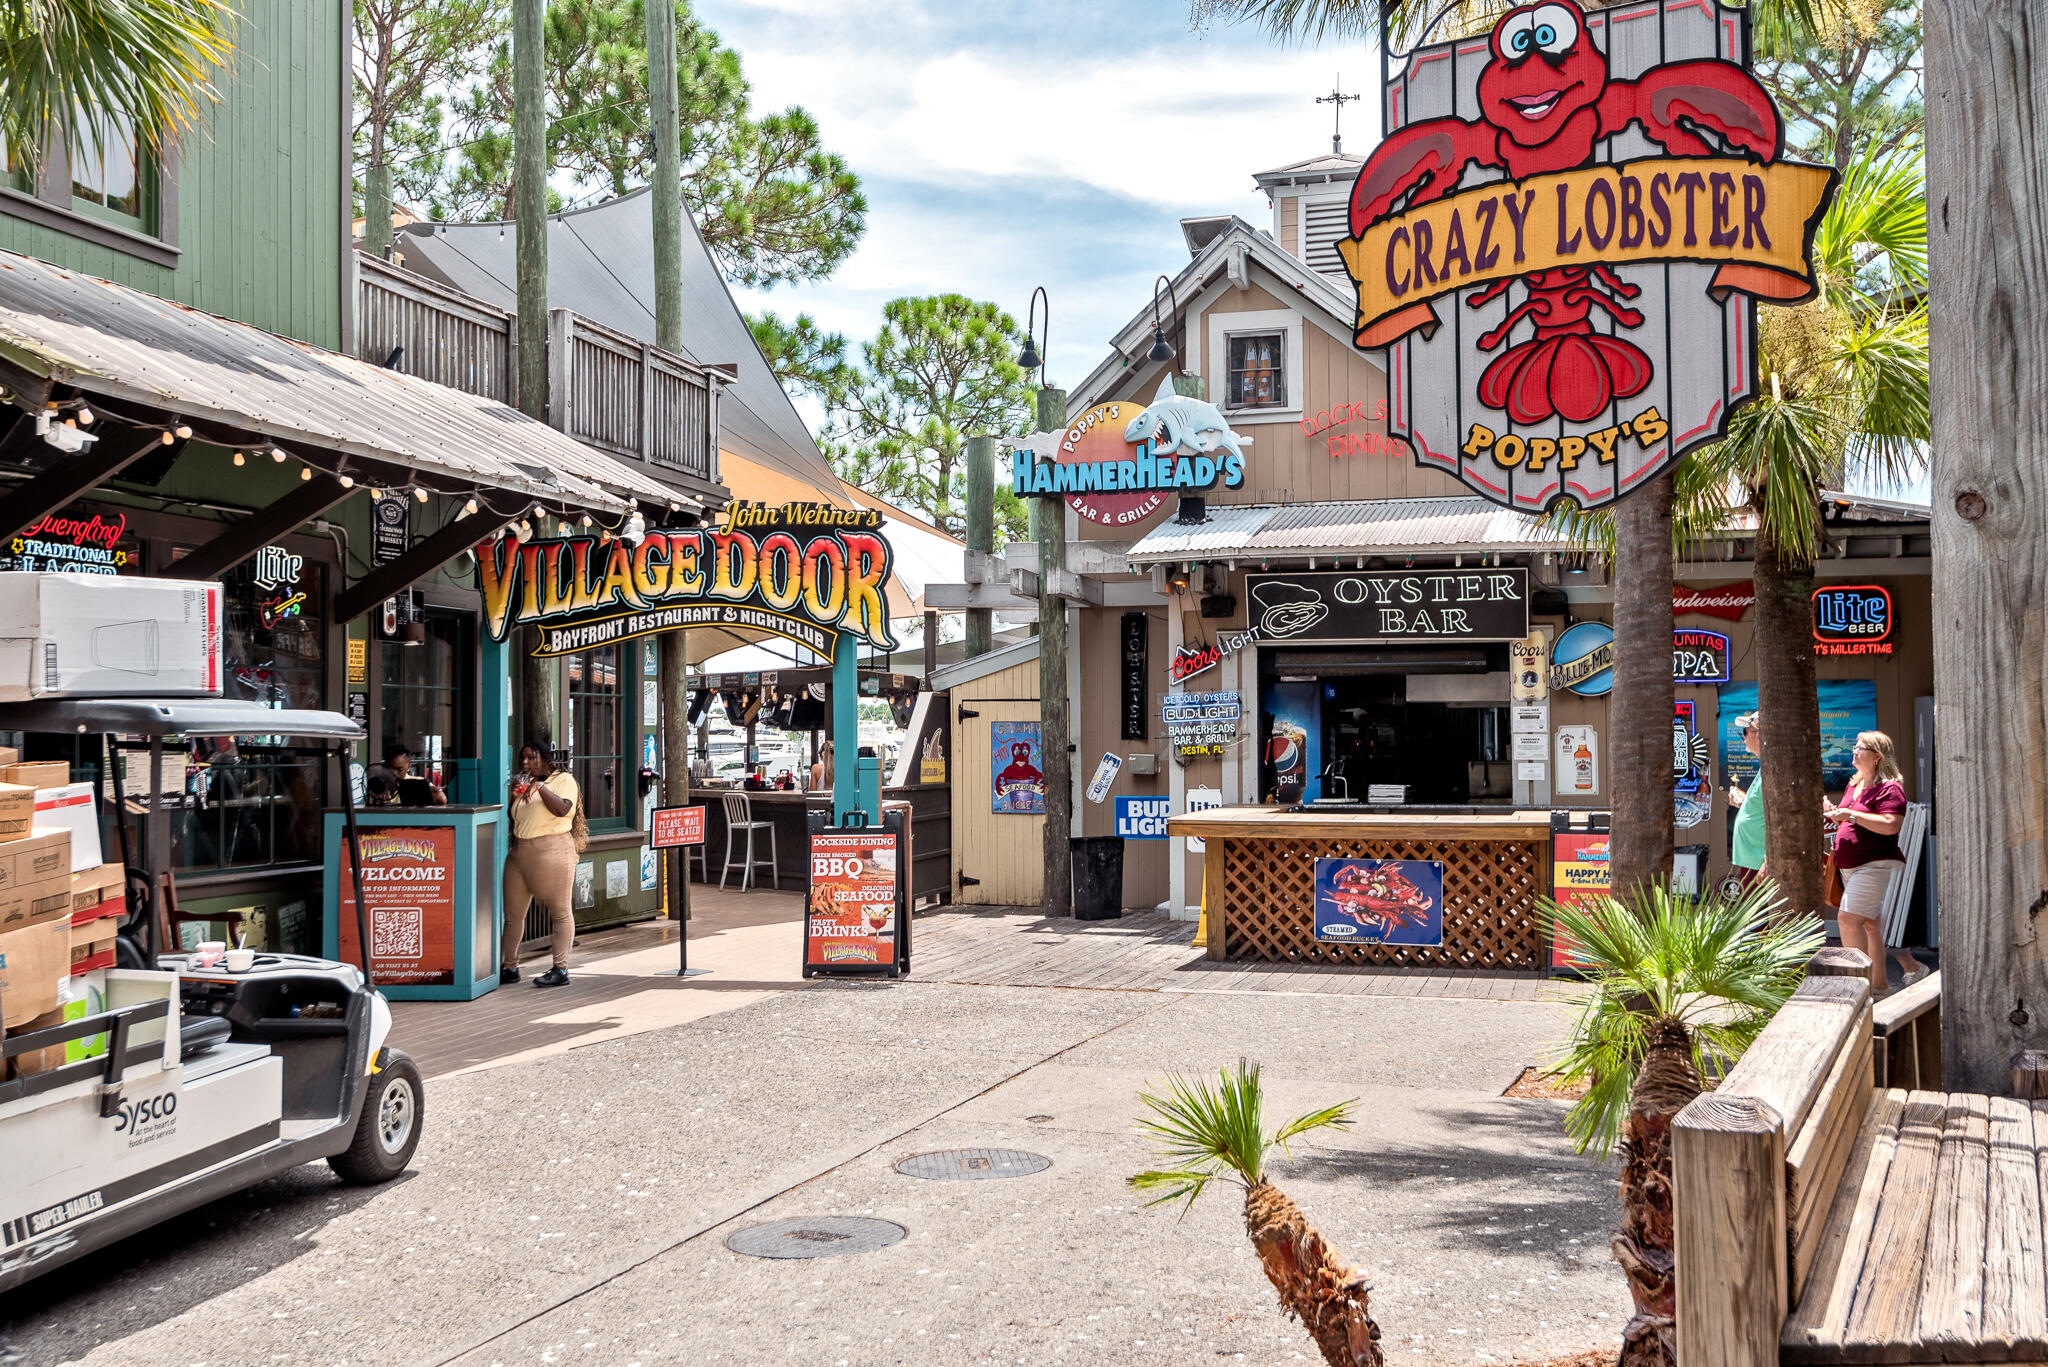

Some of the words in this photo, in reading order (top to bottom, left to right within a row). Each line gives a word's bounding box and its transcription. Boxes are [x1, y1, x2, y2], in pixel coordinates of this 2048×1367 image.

[1384, 188, 1537, 298] CRAZY
[1555, 170, 1773, 256] LOBSTER
[1063, 405, 1120, 453] POPPY'S
[1300, 401, 1365, 438] DOCK
[1328, 432, 1408, 457] DINING
[1463, 405, 1670, 473] POPPY'S
[1071, 496, 1097, 520] BAR
[1101, 513, 1112, 524] &
[1117, 494, 1162, 524] GRILLE
[720, 500, 780, 538] John
[780, 501, 881, 527] Wehner's
[23, 539, 116, 564] TRADITIONAL
[253, 545, 303, 591] Lite
[474, 532, 705, 639] VILLAGE
[705, 529, 892, 647] DOOR
[1334, 575, 1522, 605] OYSTER
[1673, 592, 1755, 608] udweiser
[1379, 607, 1473, 634] BAR
[1817, 592, 1886, 631] Lite
[551, 619, 625, 653] BAYFRONT
[628, 606, 721, 634] RESTAURANT
[723, 606, 738, 622] &
[740, 609, 825, 650] NIGHTCLUB
[1848, 623, 1885, 634] BEER
[1172, 645, 1222, 678] Coors
[1218, 625, 1261, 656] LIGHT
[1512, 641, 1545, 657] Coors
[1674, 634, 1724, 651] UNITAS
[1830, 643, 1866, 655] MILLER
[1866, 642, 1893, 655] TIME
[1550, 658, 1590, 691] BLUE
[1163, 696, 1176, 705] ICE
[1178, 694, 1200, 704] COLD
[1203, 692, 1239, 702] OYSTERS
[1166, 708, 1196, 720] BUD
[1198, 706, 1237, 718] LIGHT
[1174, 735, 1192, 745] BAR
[1194, 734, 1203, 744] &
[1205, 733, 1231, 743] GRILL
[1181, 745, 1211, 755] DESTIN,
[1213, 745, 1224, 754] FL
[1004, 783, 1036, 792] SEAFOOD
[1127, 800, 1170, 818] BUD
[659, 818, 682, 829] PLEASE
[683, 816, 700, 827] WAIT
[1119, 818, 1168, 835] LIGH
[658, 829, 666, 839] TO
[667, 828, 675, 838] BE
[676, 826, 701, 836] SEATED
[813, 838, 859, 847] DOCKSIDE
[860, 837, 894, 846] DINING
[359, 838, 403, 862] VILLAGE
[403, 839, 438, 863] DOOR
[813, 857, 864, 881] BBQ
[1565, 869, 1602, 878] HAPPY
[834, 891, 894, 902] SEAFOOD
[811, 918, 838, 926] TASTY
[811, 925, 869, 937] DRINKS
[371, 970, 442, 978] TheVillageDoor.com
[115, 1091, 177, 1135] Sysco
[154, 1120, 169, 1130] heart
[128, 1139, 143, 1148] food
[144, 1132, 155, 1143] and
[156, 1127, 177, 1140] service
[31, 1190, 104, 1233] SUPER-HAULER
